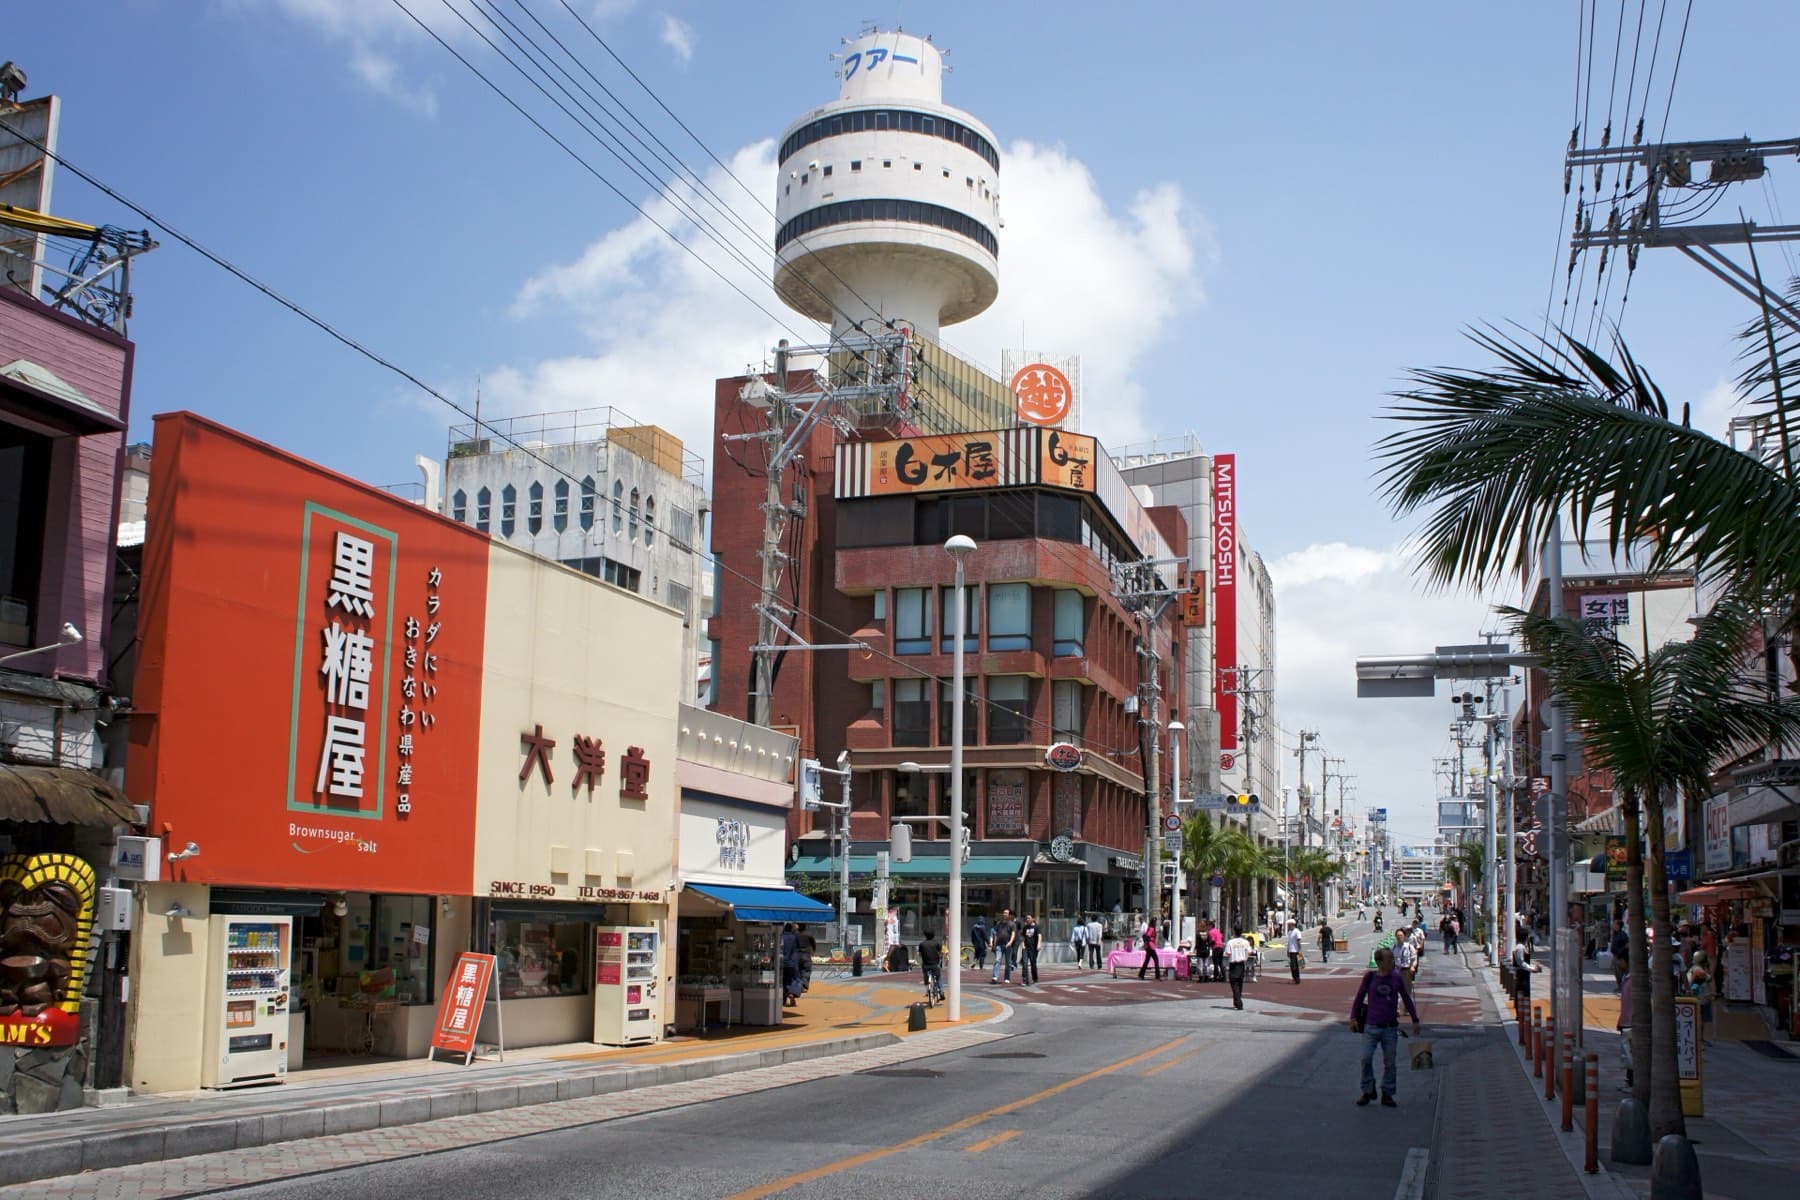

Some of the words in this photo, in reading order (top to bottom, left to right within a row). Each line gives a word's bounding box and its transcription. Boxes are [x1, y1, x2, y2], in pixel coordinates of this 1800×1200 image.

[895, 442, 996, 486] 白木屋
[1217, 463, 1233, 586] MITSUKOSHI
[316, 531, 375, 798] 黒糖屋
[420, 567, 442, 726] カラダにいい
[397, 616, 420, 813] おきなわ県産品
[519, 724, 651, 801] 大洋堂
[289, 823, 355, 843] Brownsugar
[357, 840, 377, 854] salt
[491, 881, 526, 894] SINCE
[529, 884, 556, 897] 1950
[578, 886, 594, 897] TEL
[448, 962, 478, 1029] 黒糖屋
